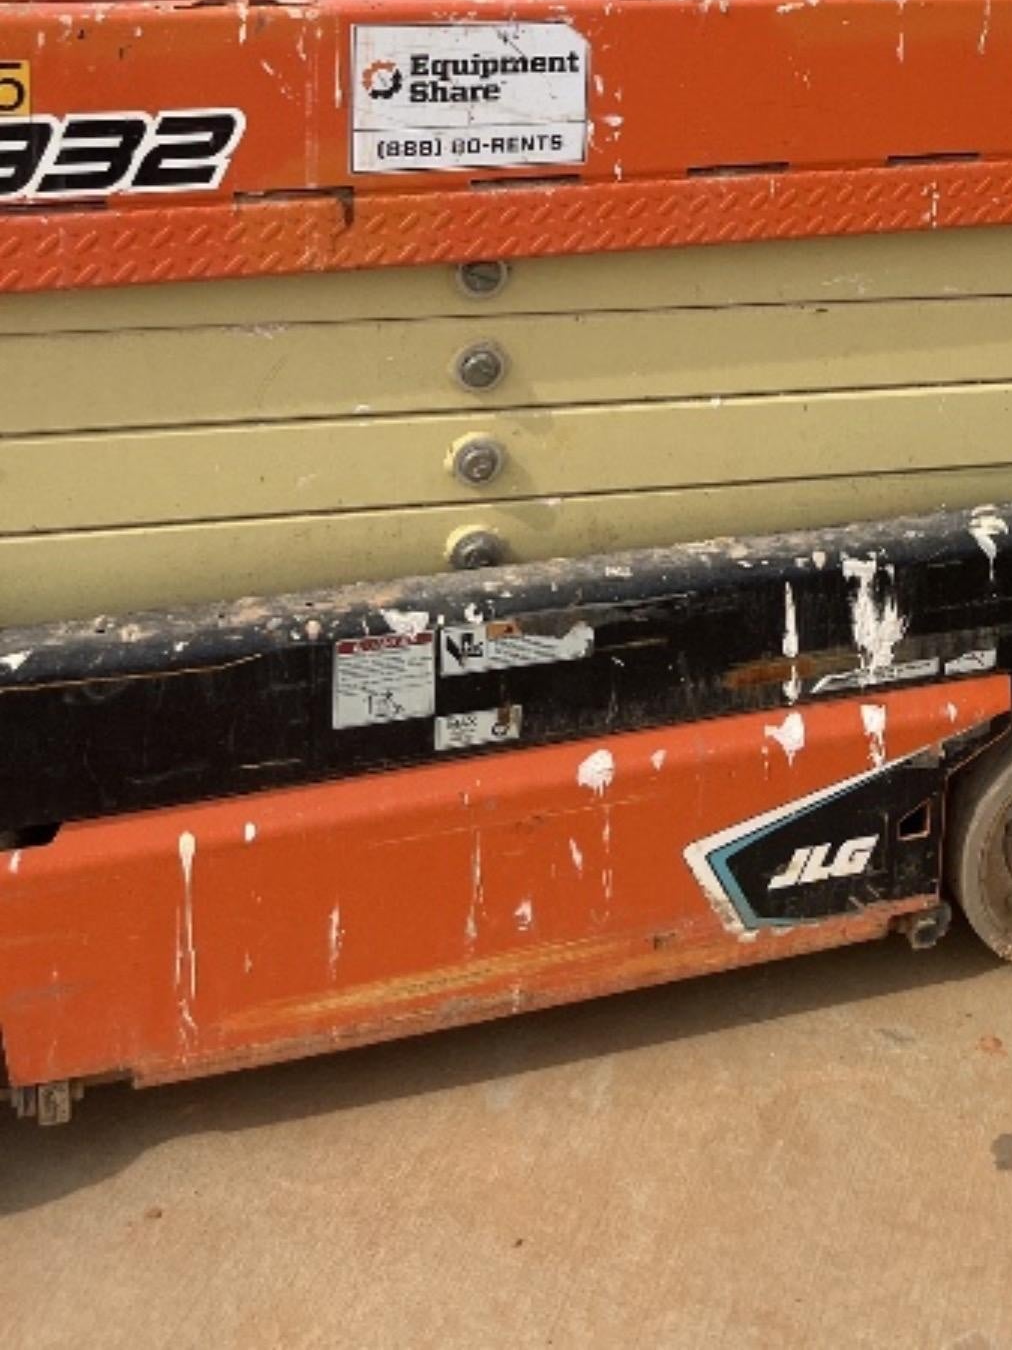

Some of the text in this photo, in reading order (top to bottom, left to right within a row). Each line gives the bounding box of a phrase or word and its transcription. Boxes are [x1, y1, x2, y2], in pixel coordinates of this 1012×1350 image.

[409, 52, 580, 80] Equipment
[409, 81, 501, 103] Share
[376, 138, 442, 160] (888)
[767, 833, 880, 890] JLG
